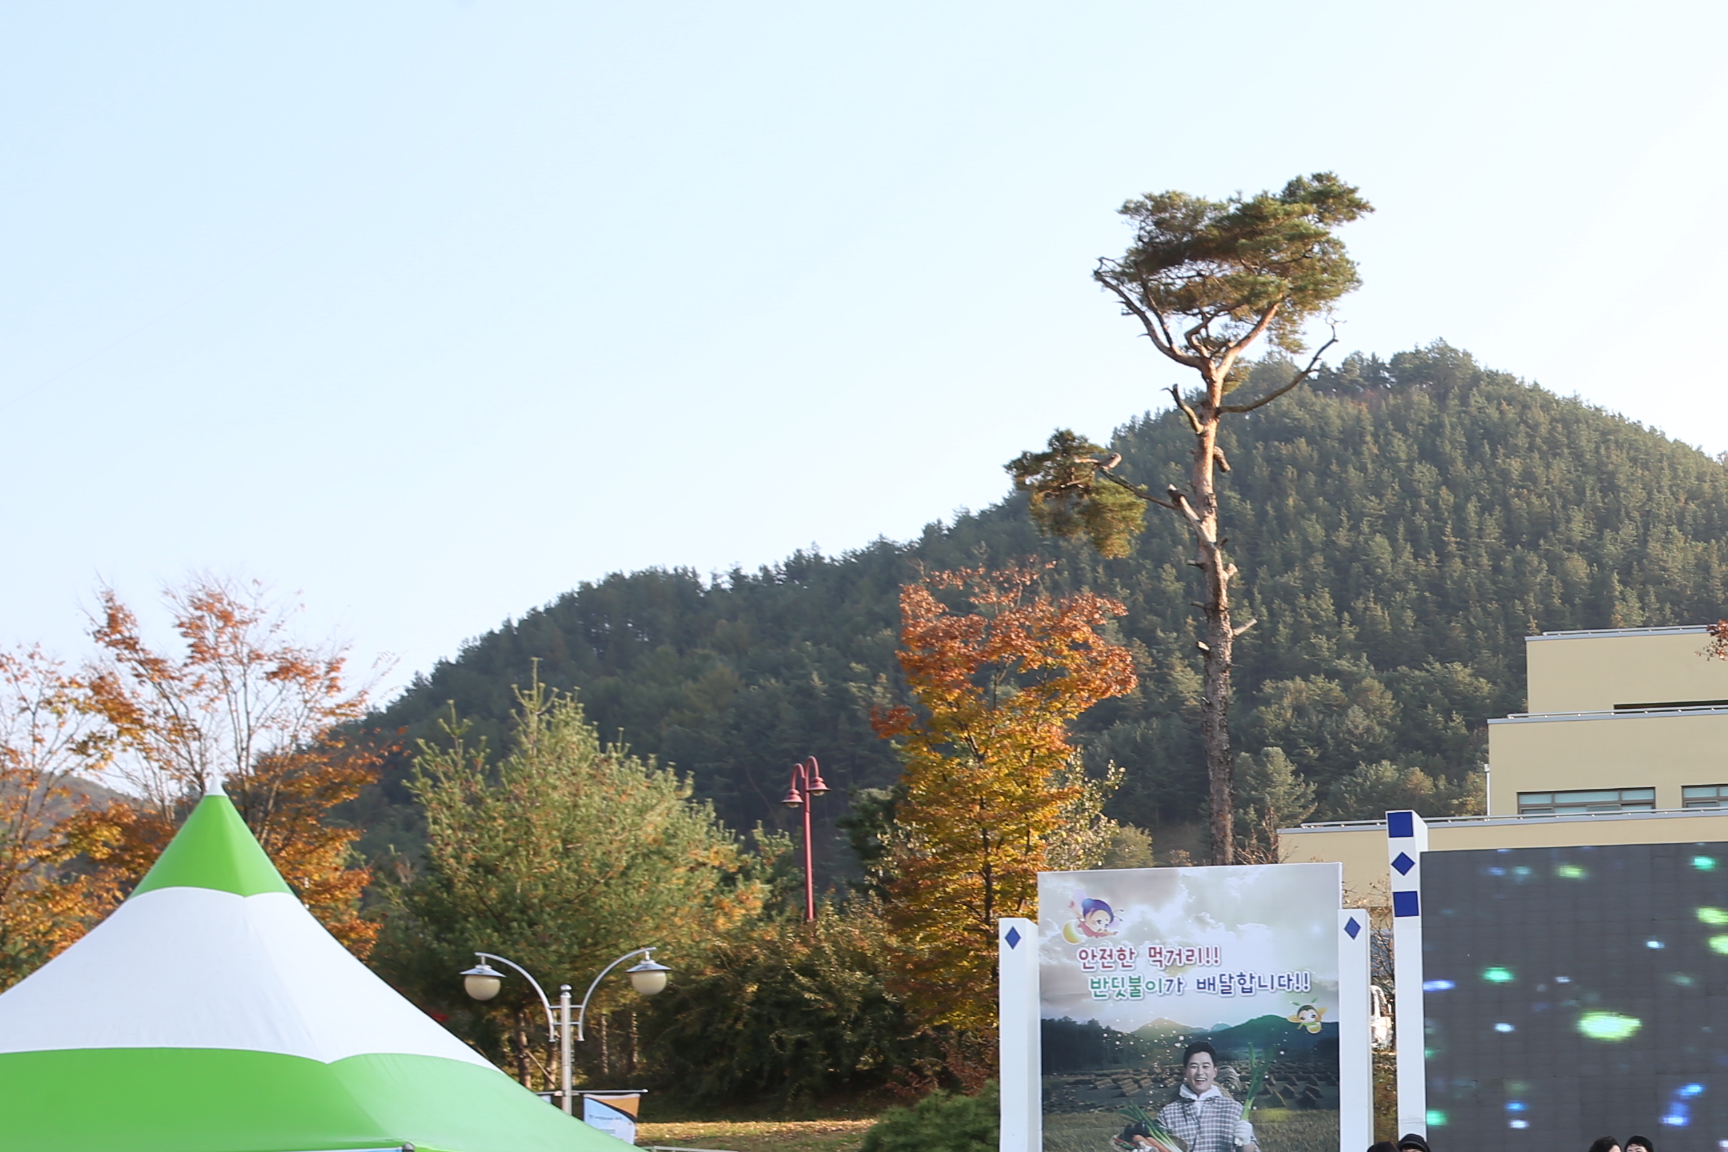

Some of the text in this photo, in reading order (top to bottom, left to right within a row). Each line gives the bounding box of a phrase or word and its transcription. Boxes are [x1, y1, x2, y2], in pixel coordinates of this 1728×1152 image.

[1078, 945, 1221, 971] 안전한 먹거리!!
[1090, 972, 1310, 999] 반딧불이가 배달합니다!!
